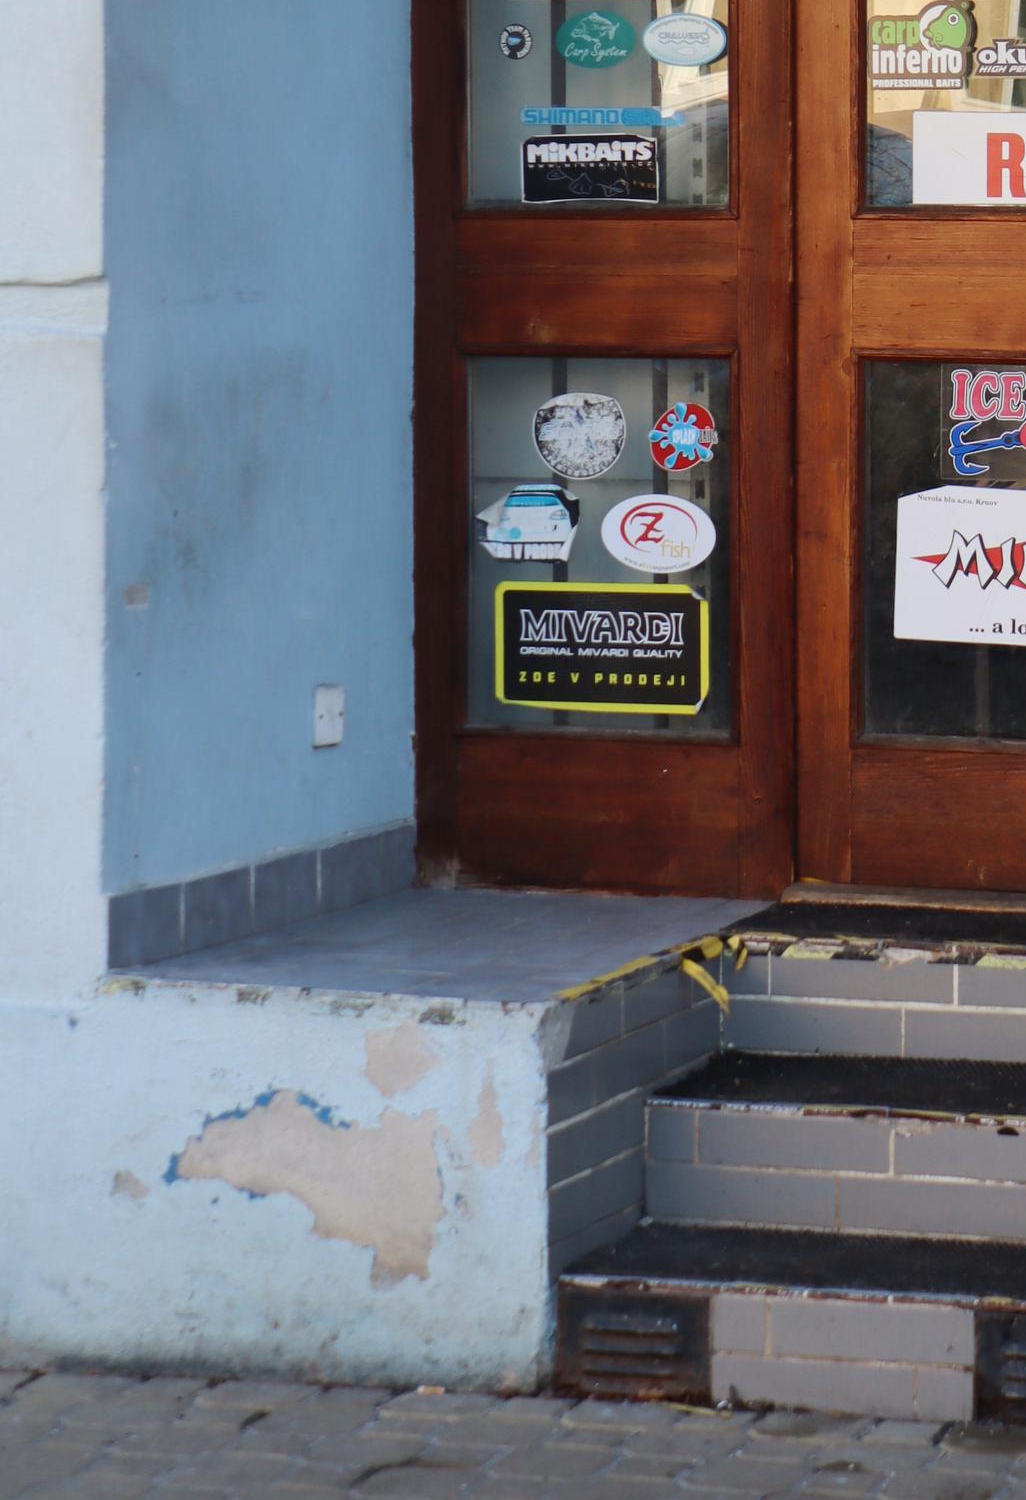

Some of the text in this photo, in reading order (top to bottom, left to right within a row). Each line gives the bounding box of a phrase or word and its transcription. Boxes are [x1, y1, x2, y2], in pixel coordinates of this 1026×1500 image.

[872, 20, 920, 48] carp
[872, 44, 962, 74] inferno
[979, 65, 1006, 73] HIGH
[872, 79, 961, 88] PROFESSIONAL BAITS
[523, 109, 619, 124] SHIMANO
[631, 512, 665, 545] Z
[660, 540, 691, 559] fish
[519, 609, 684, 645] MIVARDI
[992, 621, 1003, 634] a
[519, 646, 683, 658] ORIGINAL MIVARDI QUALITY
[519, 670, 686, 686] ZDE V PRODEJI
